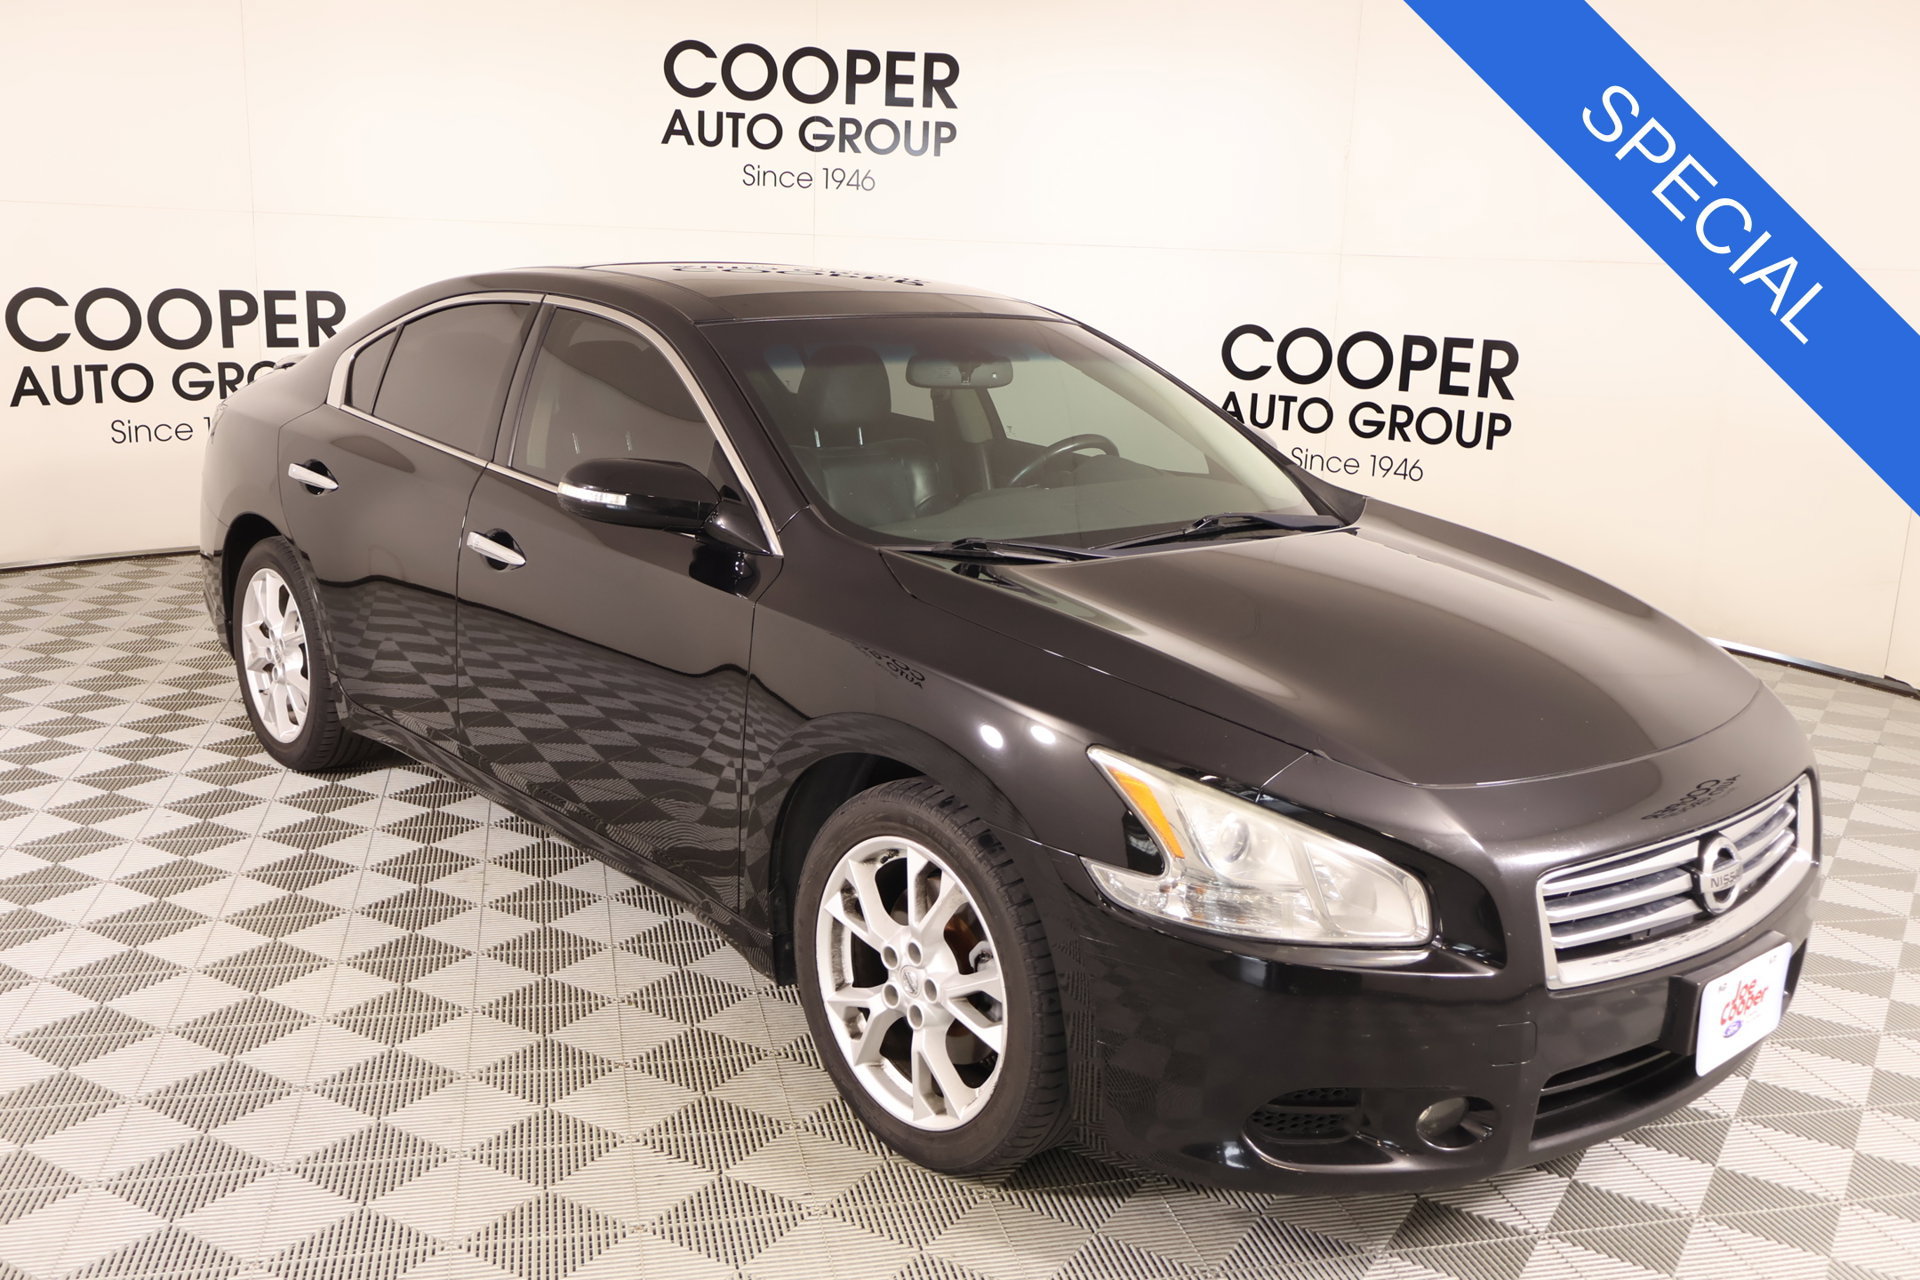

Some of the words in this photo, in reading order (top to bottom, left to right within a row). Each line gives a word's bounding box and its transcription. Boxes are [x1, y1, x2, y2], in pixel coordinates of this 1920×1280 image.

[663, 39, 960, 109] COOPER
[661, 109, 783, 150] AUTO
[798, 115, 957, 157] GROUP
[742, 164, 813, 189] Since
[822, 167, 875, 191] 1946
[5, 287, 346, 352] COOPER
[10, 363, 154, 407] AUTO
[1221, 324, 1519, 400] COOPER
[110, 419, 193, 444] Since
[1221, 391, 1333, 434] AUTO
[1349, 401, 1512, 450] GROUP
[1291, 447, 1360, 474] Since
[1369, 454, 1423, 482] 1946
[1710, 871, 1738, 889] NISS
